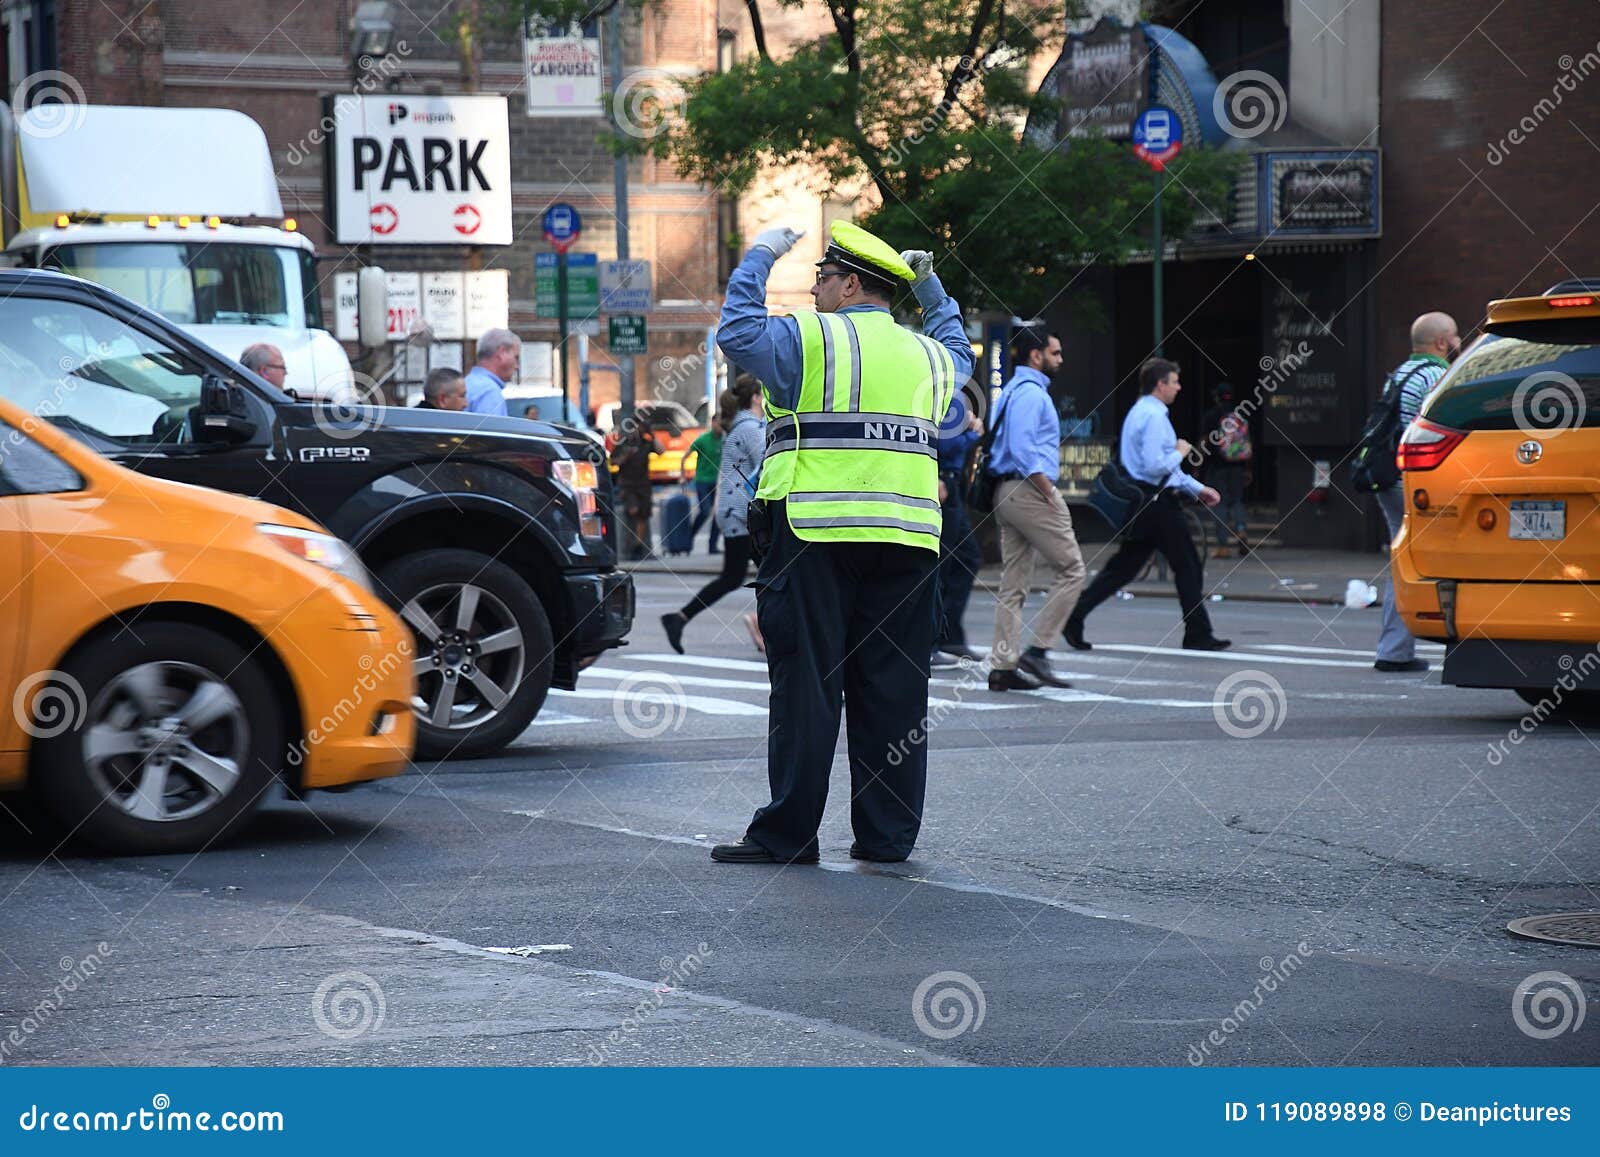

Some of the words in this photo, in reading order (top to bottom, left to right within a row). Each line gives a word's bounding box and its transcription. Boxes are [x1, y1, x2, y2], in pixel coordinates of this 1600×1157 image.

[531, 63, 595, 75] CAROUSEL
[352, 137, 492, 191] PARK
[608, 264, 643, 273] NYPD
[863, 422, 929, 445] NYPD
